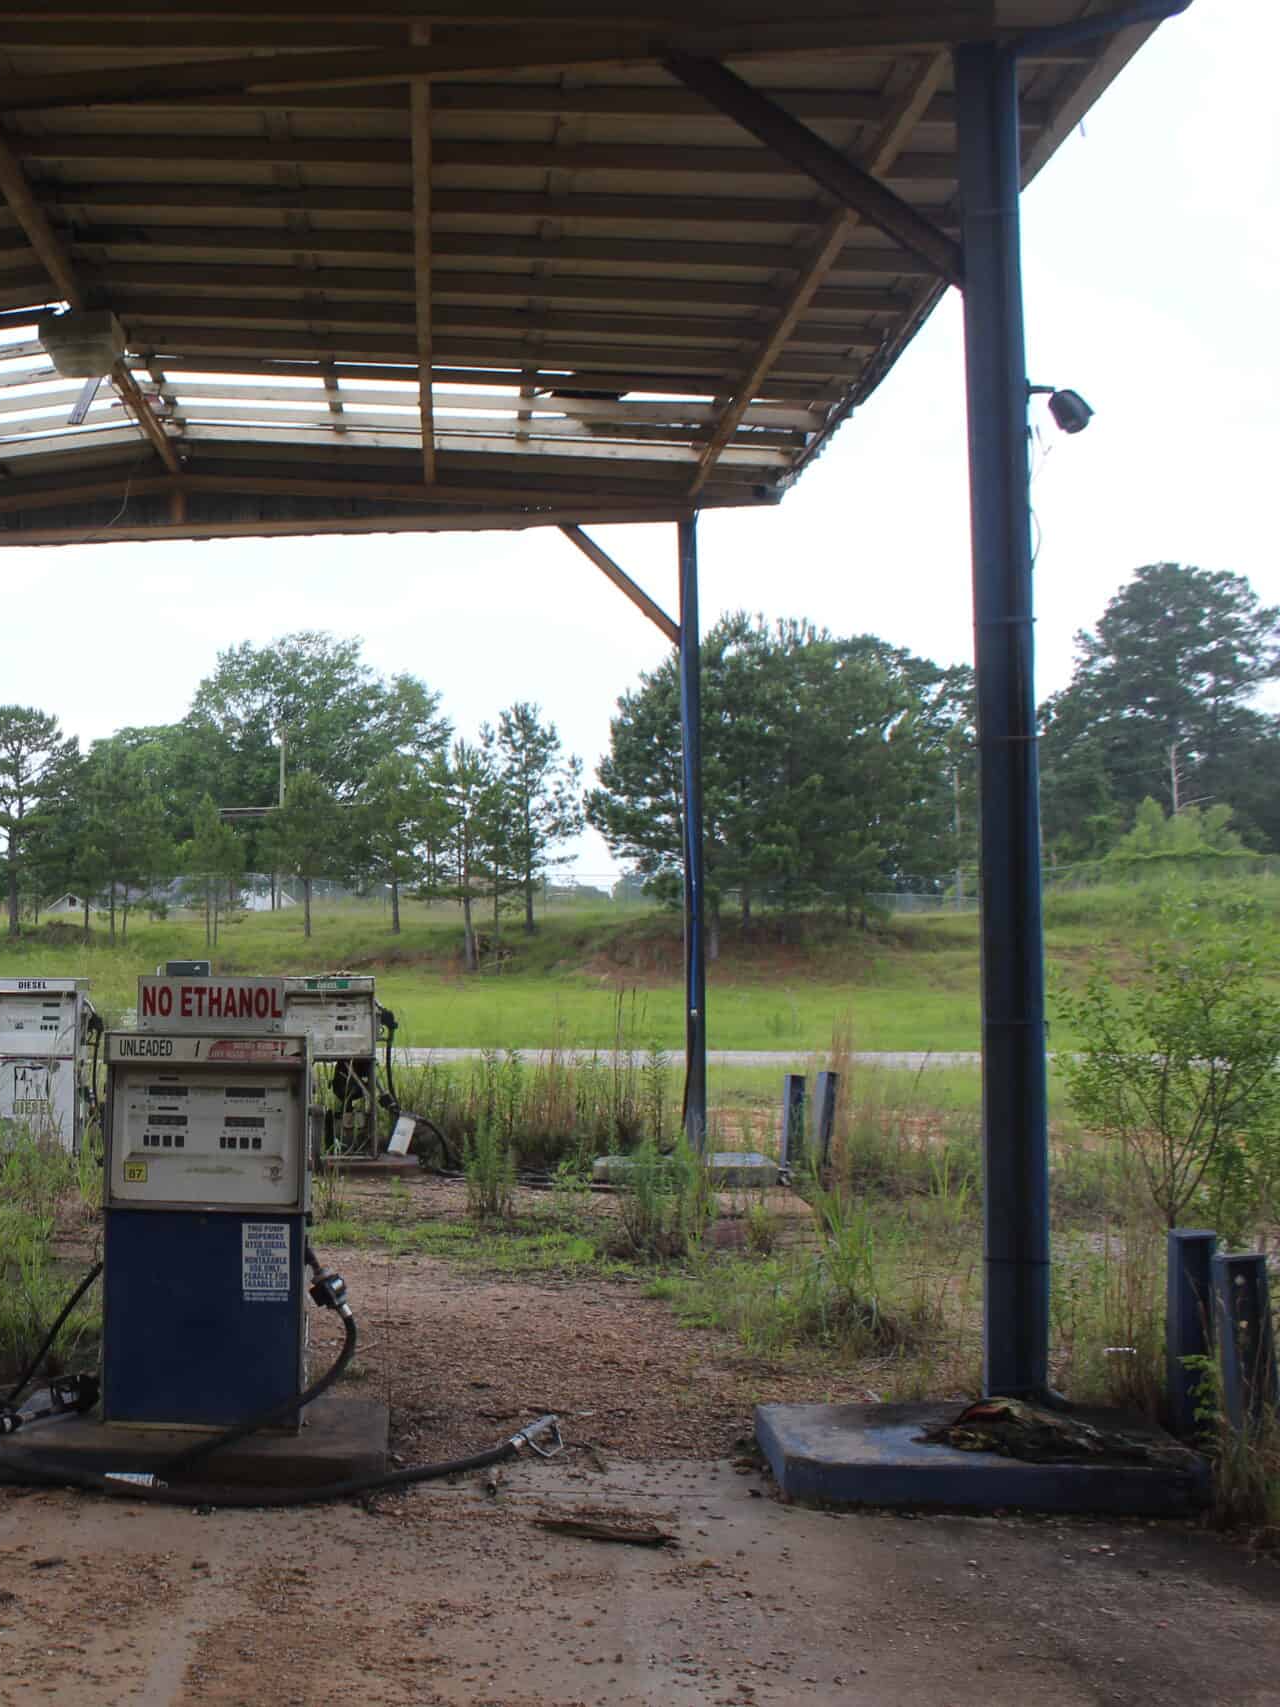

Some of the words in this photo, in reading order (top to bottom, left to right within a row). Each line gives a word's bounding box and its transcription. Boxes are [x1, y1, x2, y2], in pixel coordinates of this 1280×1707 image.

[18, 981, 47, 990] DIESEL
[142, 985, 172, 1017] NO
[180, 986, 282, 1019] ETHANOL
[119, 1039, 173, 1057] UNLEADED
